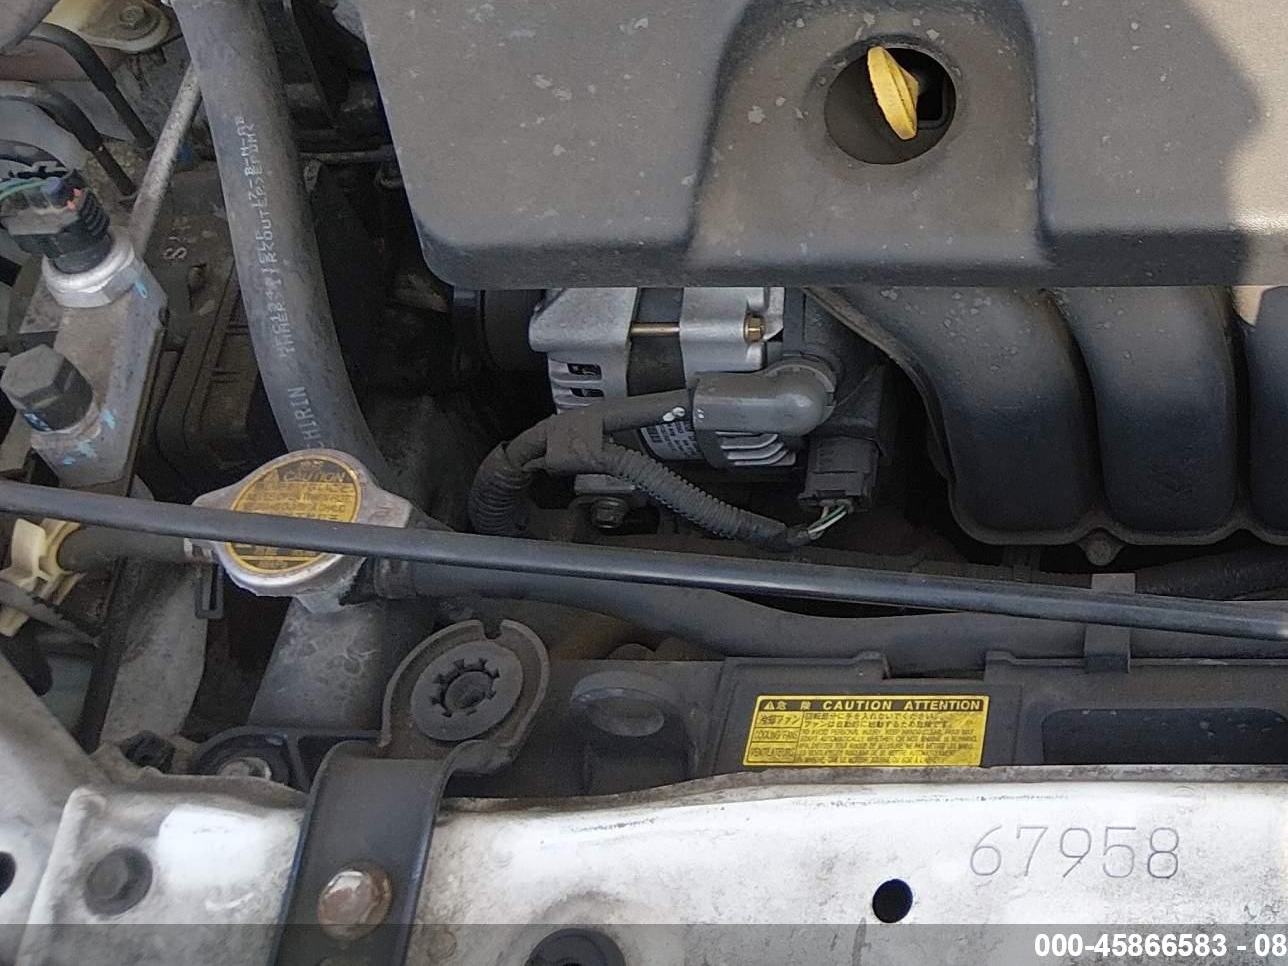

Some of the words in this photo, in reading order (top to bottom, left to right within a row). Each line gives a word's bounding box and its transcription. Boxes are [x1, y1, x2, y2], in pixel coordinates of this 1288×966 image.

[283, 470, 345, 483] CAUTION
[823, 701, 893, 710] CAUTION
[903, 701, 980, 710] ATTENTION
[969, 825, 1179, 879] 67958
